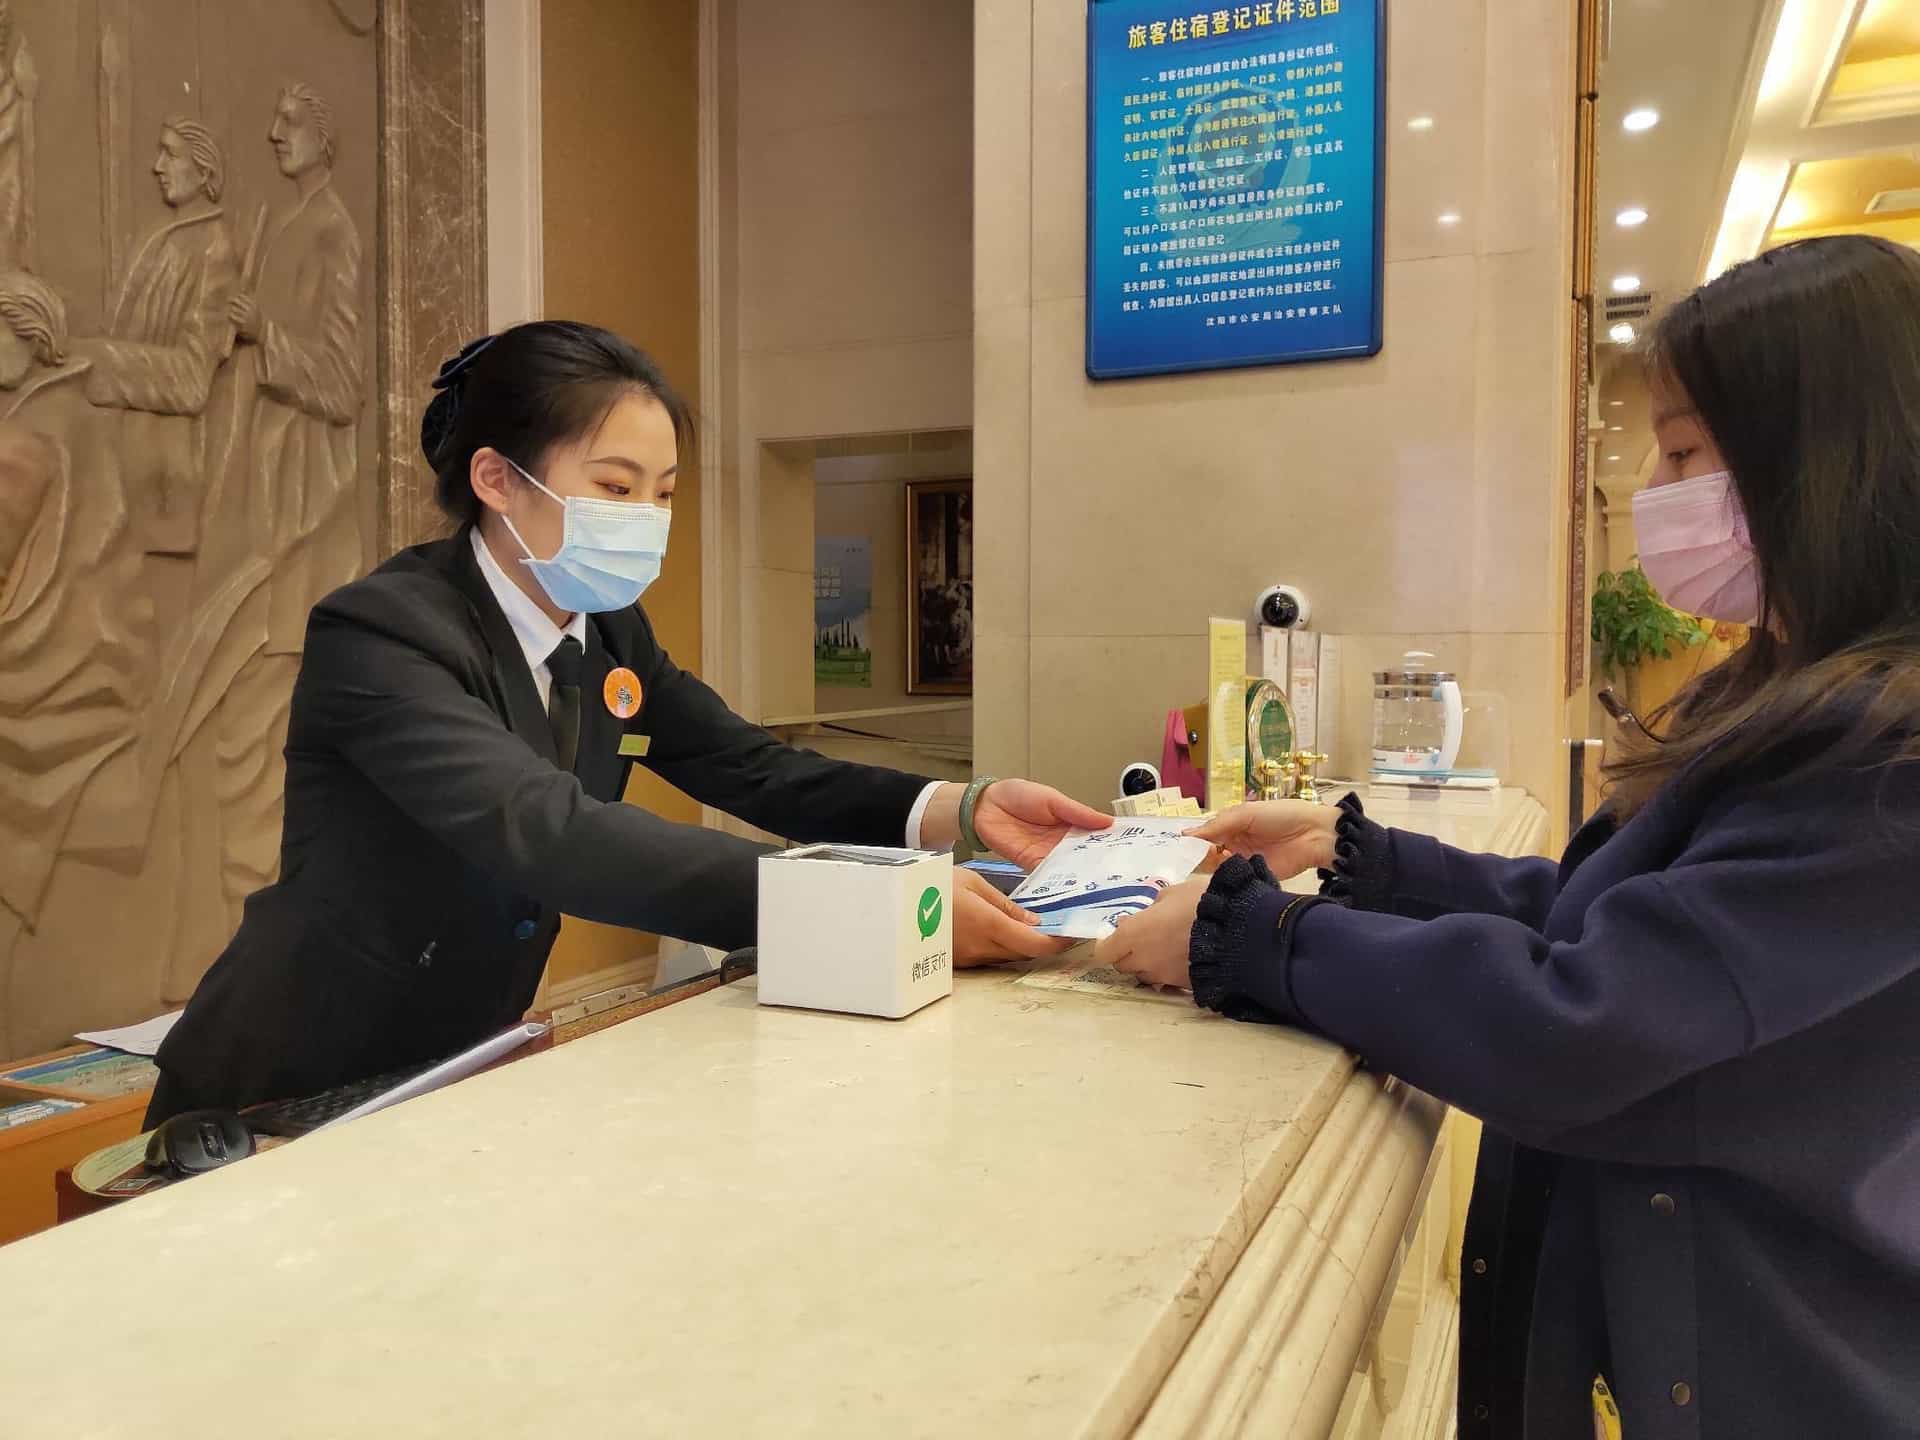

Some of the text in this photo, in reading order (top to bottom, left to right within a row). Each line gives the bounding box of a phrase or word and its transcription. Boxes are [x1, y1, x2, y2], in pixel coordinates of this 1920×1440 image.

[1127, 0, 1341, 49] 旅客住宿登记证件范围
[911, 950, 947, 983] 微信支付
